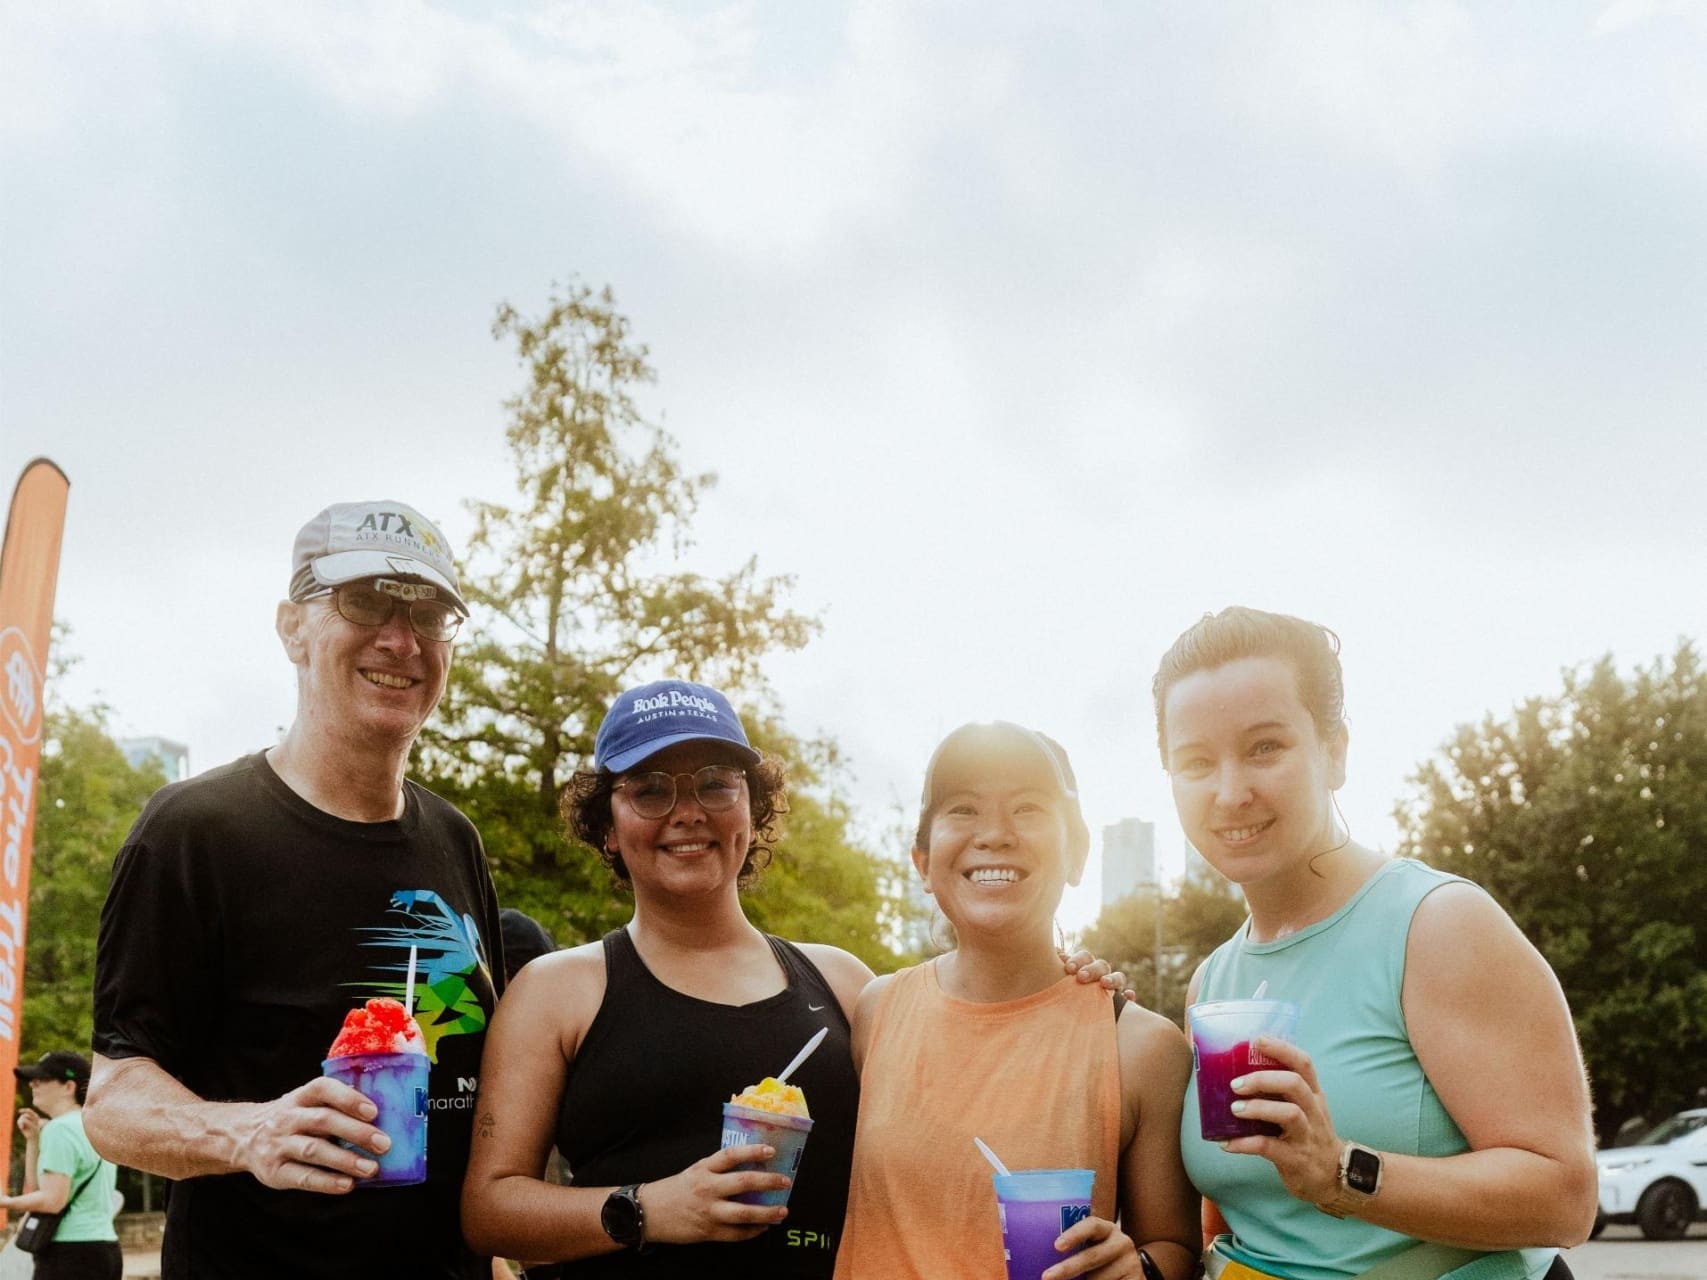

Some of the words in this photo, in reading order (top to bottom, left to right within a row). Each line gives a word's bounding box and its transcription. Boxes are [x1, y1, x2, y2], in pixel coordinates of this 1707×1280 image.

[357, 512, 414, 538] ATX
[632, 692, 669, 714] Book
[668, 690, 718, 713] People
[636, 709, 676, 725] AUSTIN
[685, 709, 718, 723] TEXAS
[4, 766, 32, 887] The
